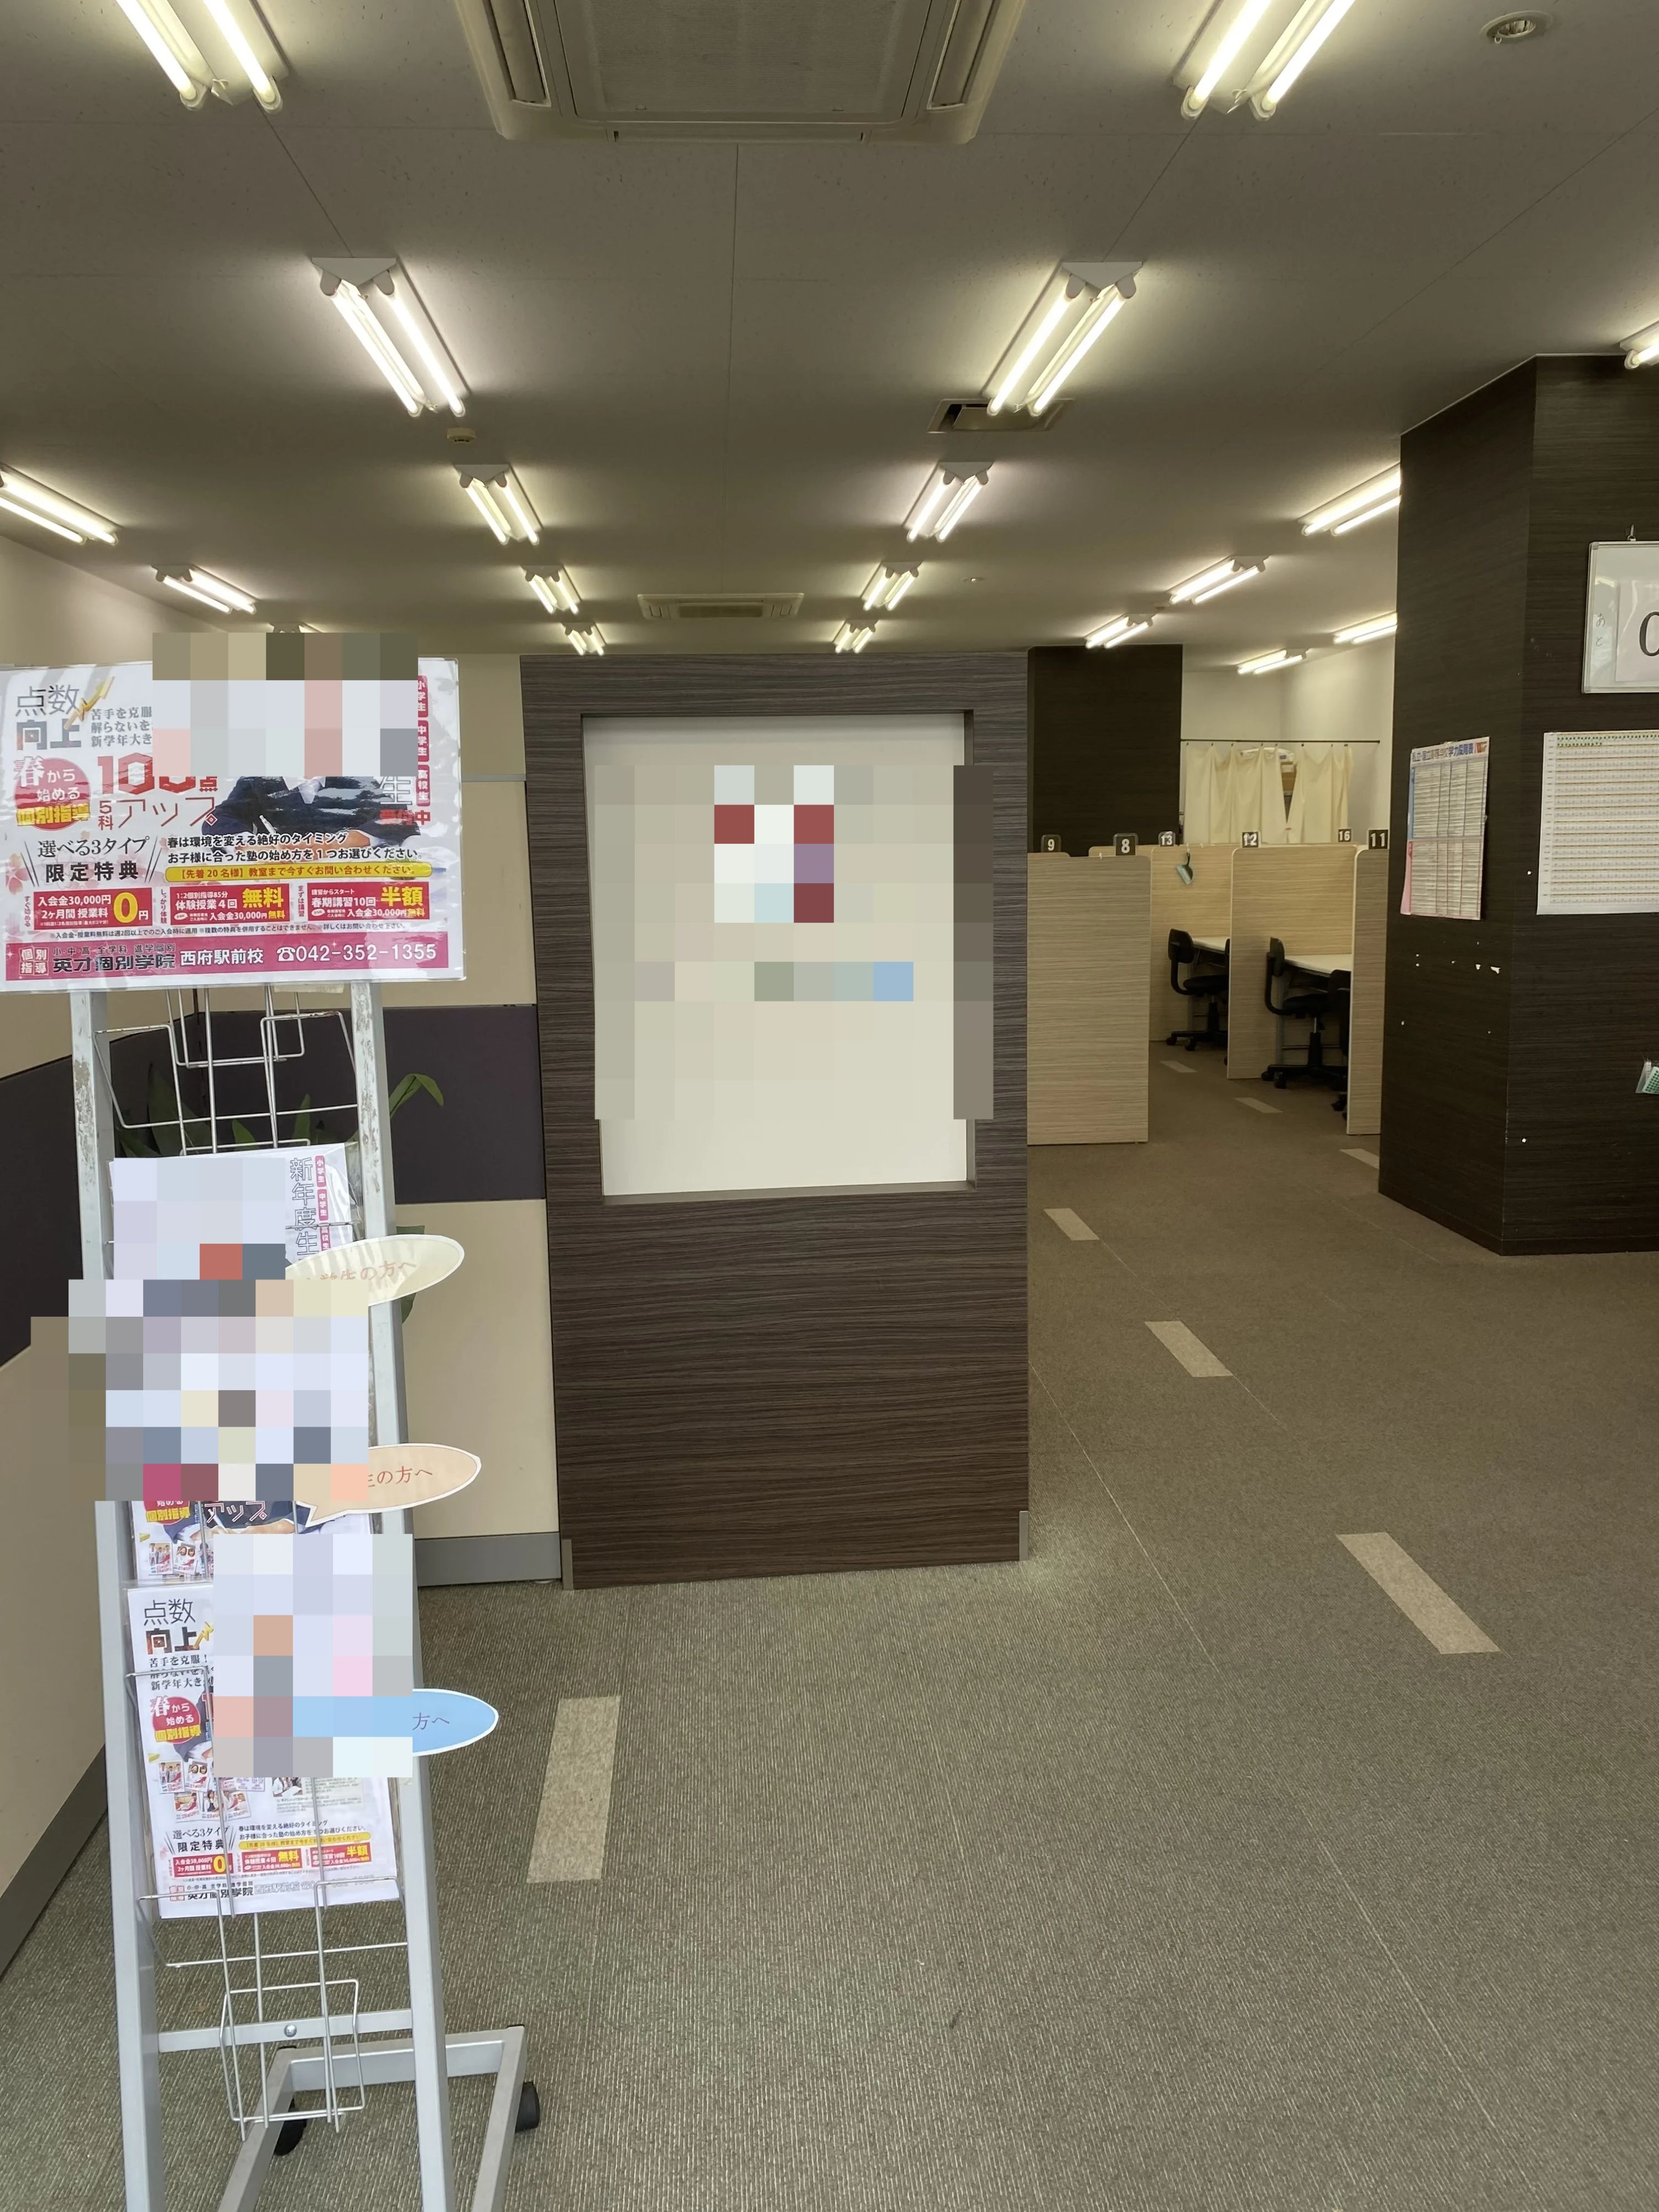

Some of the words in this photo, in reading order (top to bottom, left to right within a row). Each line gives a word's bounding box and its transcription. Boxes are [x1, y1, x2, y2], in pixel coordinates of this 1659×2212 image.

[15, 685, 80, 717] 点数
[16, 719, 82, 751] 向上
[14, 756, 76, 787] 春から
[36, 786, 81, 801] 始める
[17, 803, 91, 826] 個別指導
[117, 796, 218, 828] アップ
[167, 832, 347, 848] 春は環境を変える絶好のタイミング
[1047, 839, 1055, 851] 9
[1161, 835, 1172, 846] 13
[1244, 833, 1257, 846] 12
[1339, 831, 1350, 841] 16
[1370, 832, 1385, 847] 11
[38, 836, 150, 858] 選べる3タイプ
[1121, 838, 1130, 854] 8
[45, 860, 139, 883] 限定特典
[38, 894, 111, 907] 入会金30,000円
[175, 899, 238, 911] 体験授業4回
[242, 886, 284, 909] 無料
[380, 886, 424, 907] 半額
[209, 911, 267, 921] 入会金30,000円
[268, 910, 285, 920] 無料
[53, 954, 176, 973] 英才個別学院
[180, 949, 264, 965] 西府駅前校
[205, 1501, 267, 1524] アップ
[143, 1598, 196, 1626] 点数
[145, 1626, 200, 1655] 向上
[150, 1695, 190, 1717] 春から
[165, 1714, 194, 1726] 始める
[278, 1850, 300, 1863] 無料
[346, 1844, 368, 1857] 半額
